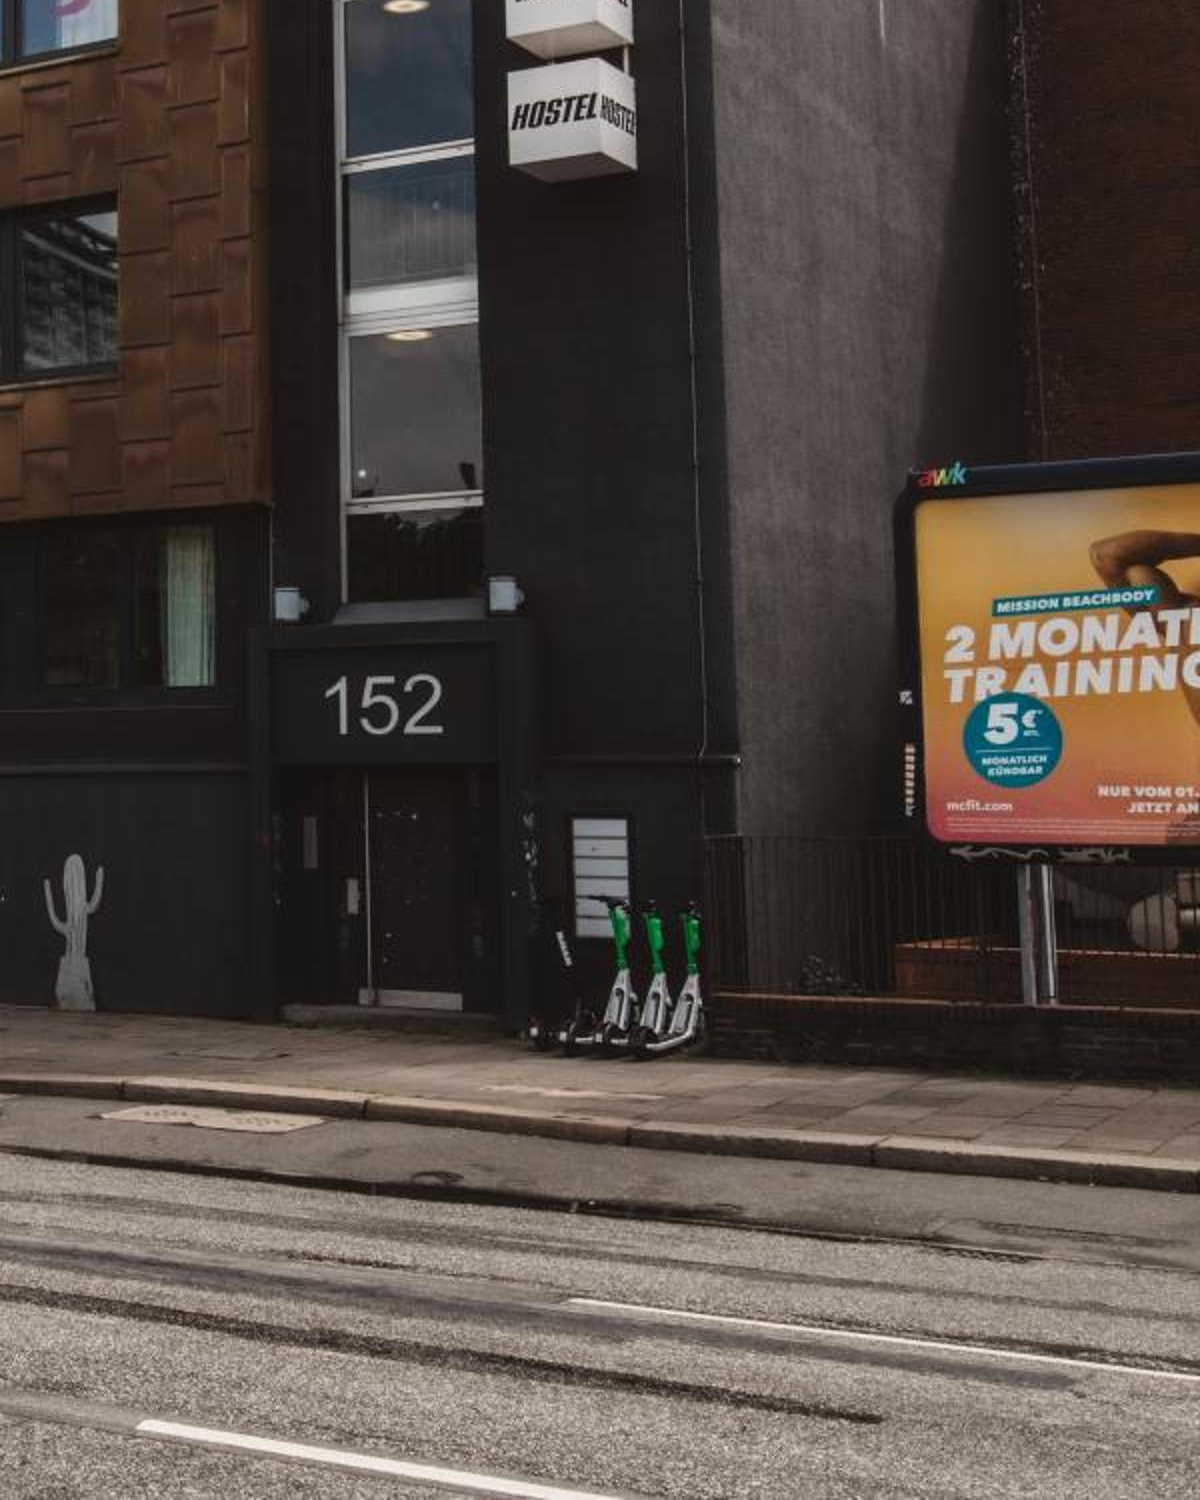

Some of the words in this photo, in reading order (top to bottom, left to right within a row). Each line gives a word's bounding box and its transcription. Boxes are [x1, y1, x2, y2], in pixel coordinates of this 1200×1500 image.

[511, 92, 598, 131] HOSTEL
[601, 94, 635, 136] HOSTEL
[918, 461, 967, 487] awk
[996, 597, 1059, 613] MISSION
[1063, 590, 1156, 608] BEACHBODY
[944, 625, 976, 663] 2
[324, 673, 444, 735] 152
[982, 755, 1047, 766] MONATLICH
[987, 765, 1043, 777] KÜNDBAR
[1097, 785, 1131, 797] NUR
[1135, 785, 1172, 798] VOM
[947, 799, 1013, 812] mcfit.com
[1127, 801, 1173, 813] JETZT
